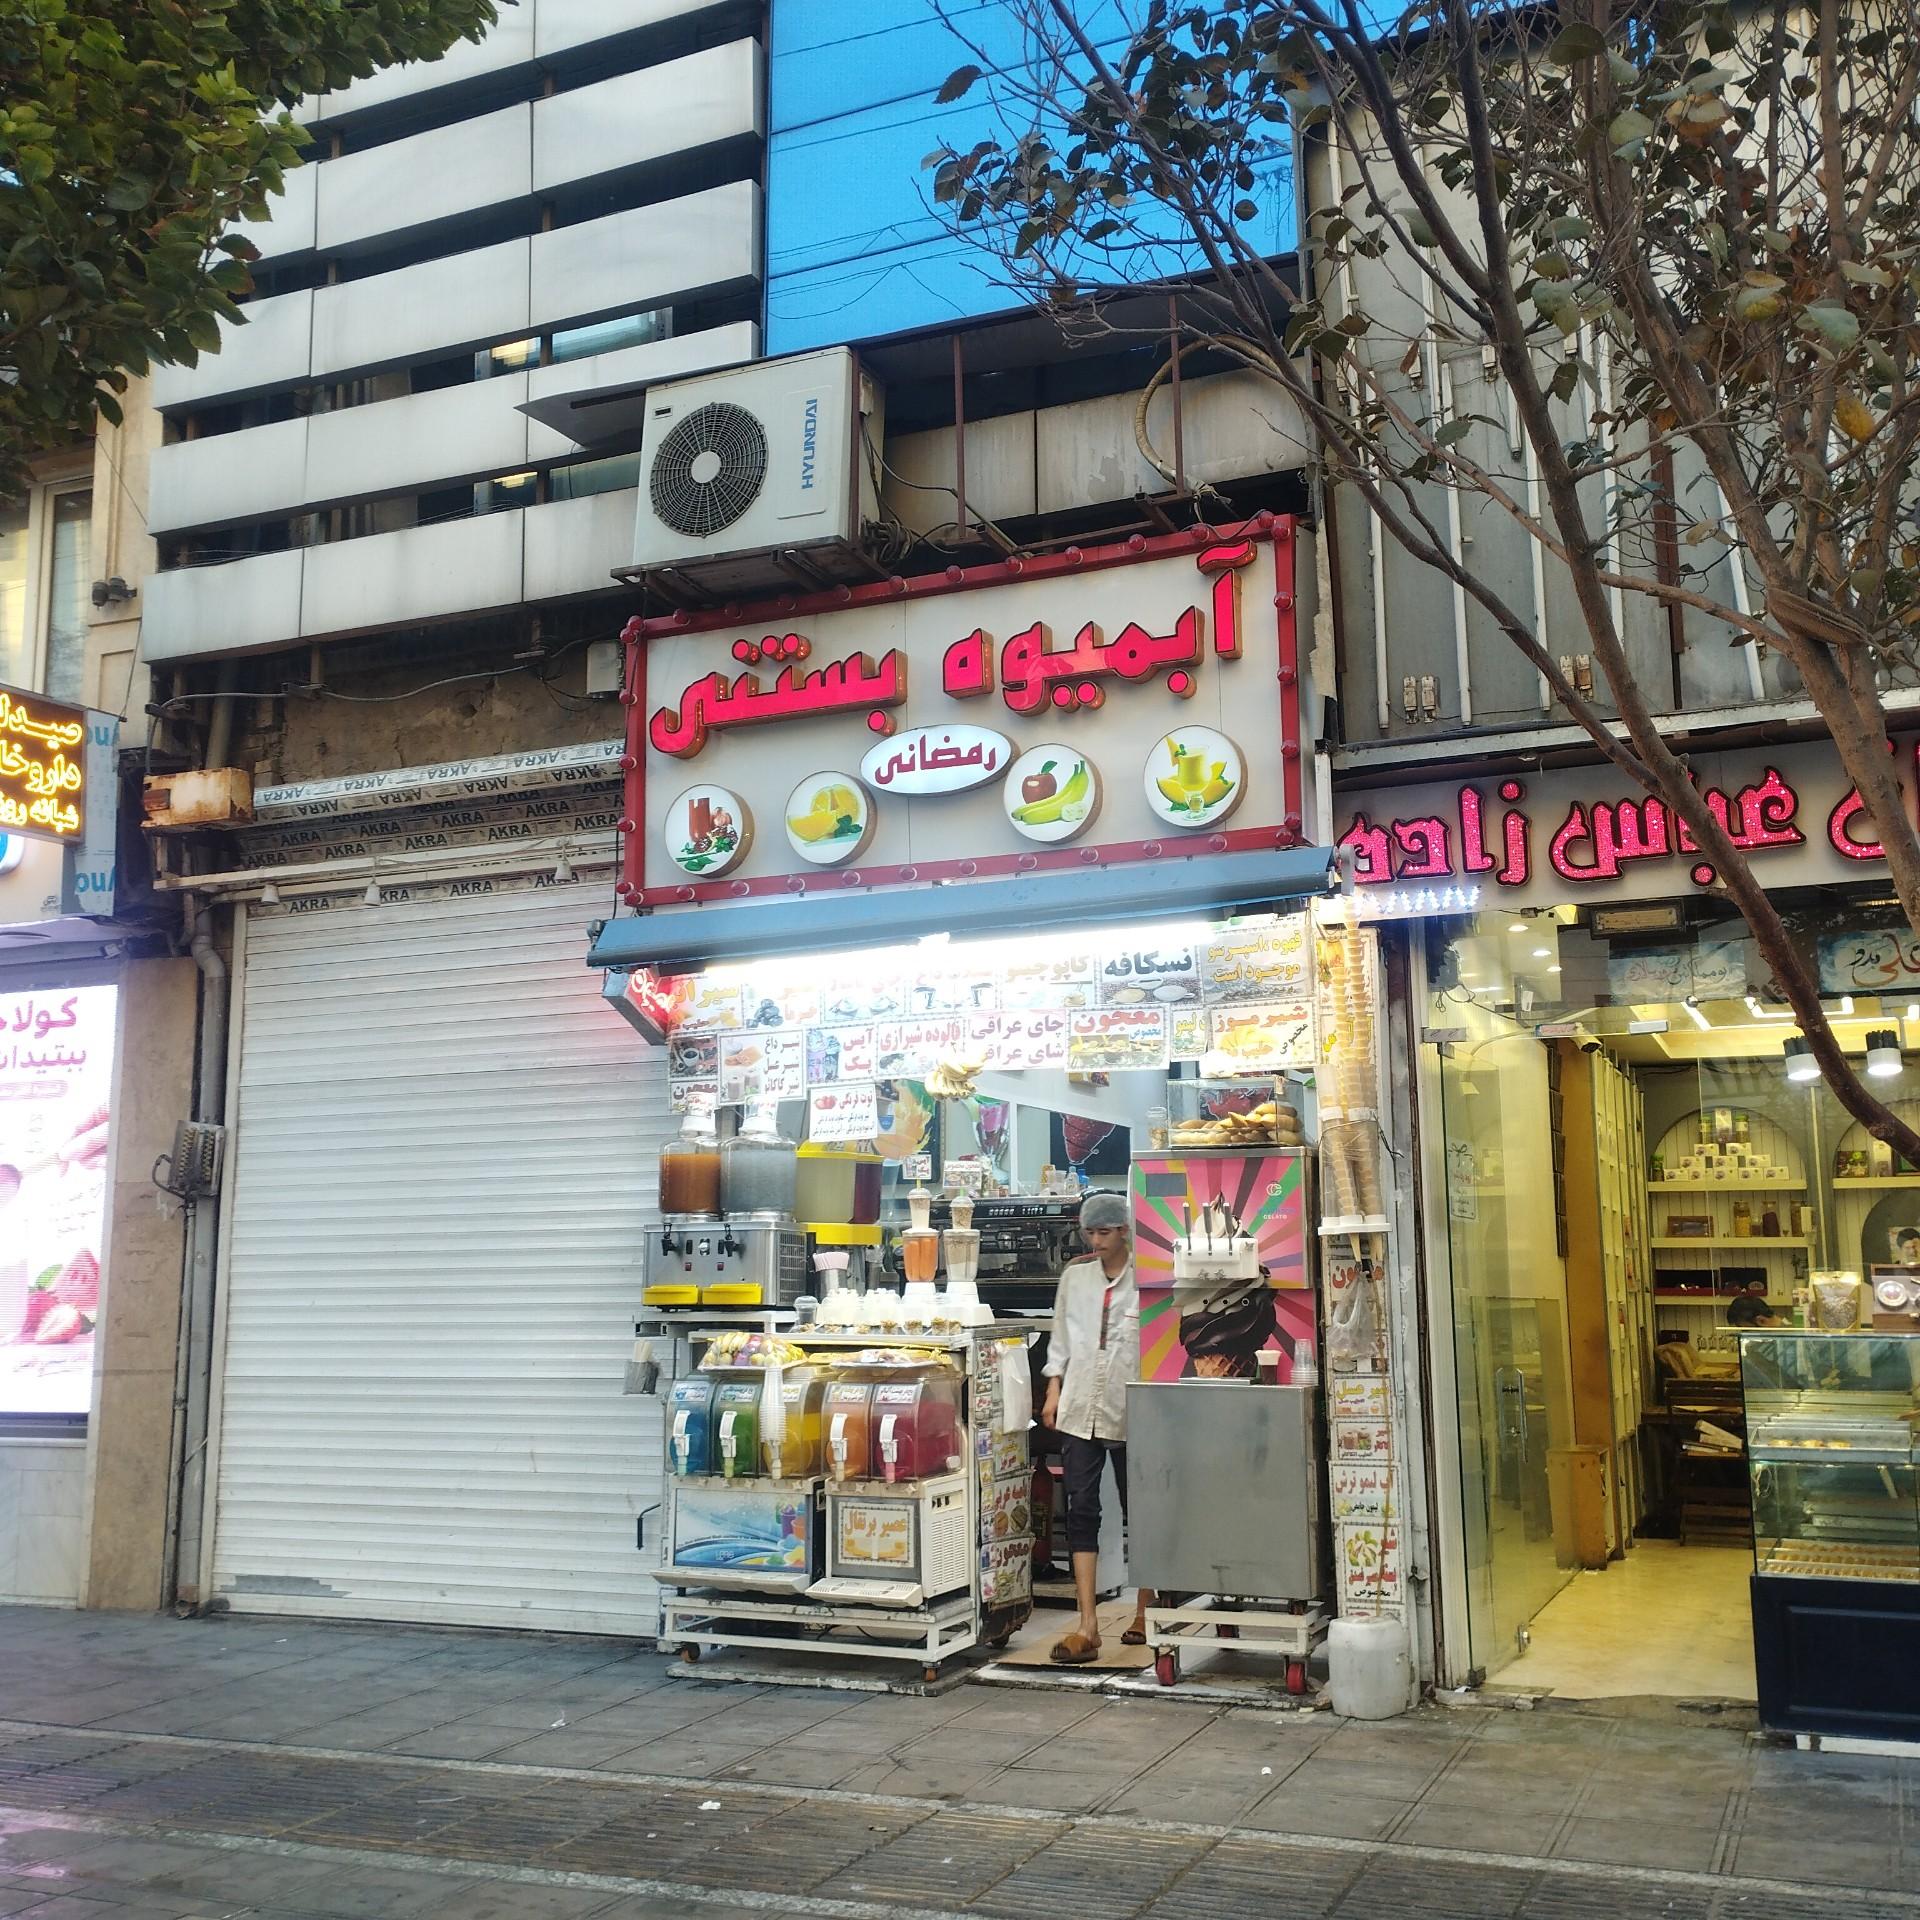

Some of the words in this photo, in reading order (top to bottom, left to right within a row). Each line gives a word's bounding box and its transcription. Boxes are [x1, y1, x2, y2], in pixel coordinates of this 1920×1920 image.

[801, 398, 817, 490] HYUNDAI
[942, 538, 1257, 717] آبمیوه
[648, 632, 907, 759] بستنی
[514, 751, 560, 767] AKRA
[873, 733, 998, 786] رمضانی
[344, 774, 389, 791] AKRA
[427, 763, 471, 780] AKRA
[552, 763, 599, 782] AKRA
[263, 786, 306, 802] AKRA
[379, 787, 423, 804] AKRA
[464, 776, 508, 793] AKRA
[29, 797, 80, 833] شبانه
[297, 799, 339, 816] AKRA
[280, 830, 321, 847] AKRA
[359, 821, 401, 838] AKRA
[441, 810, 485, 828] AKRA
[526, 800, 570, 818] AKRA
[1336, 779, 1532, 886] زاده
[248, 852, 287, 868] AKRA
[325, 843, 366, 860] AKRA
[405, 832, 448, 850] AKRA
[488, 823, 532, 841] AKRA
[574, 813, 619, 831] AKRA
[289, 897, 330, 914] AKRA
[450, 880, 493, 897] AKRA
[534, 871, 580, 889] AKA
[1271, 930, 1303, 956] قهوه
[1104, 946, 1193, 977] نسکافه
[1213, 962, 1243, 984] است
[1245, 963, 1301, 984] موجود
[1027, 1014, 1064, 1038] چای
[1073, 1008, 1161, 1034] معجون
[1215, 1013, 1260, 1033] موز
[1260, 1004, 1309, 1028] شیر
[842, 1027, 875, 1051] آیس
[879, 1024, 923, 1051] شیرازی
[924, 1022, 961, 1045] فالوده
[971, 1016, 1023, 1041] عراقی
[1281, 1022, 1309, 1055] مخصوص
[764, 1036, 778, 1055] داغ
[782, 1034, 800, 1050] شیر
[844, 1057, 873, 1074] پک
[984, 1046, 1023, 1066] عراق
[1028, 1043, 1065, 1065] شای
[1263, 1213, 1288, 1221] GELATO
[1332, 1265, 1385, 1290] مون
[1336, 1380, 1365, 1400] عسل
[1335, 1471, 1357, 1494] ترش
[1359, 1471, 1377, 1495] لیمو
[844, 1510, 877, 1537] برتقال
[880, 1516, 907, 1538] عصیر
[1354, 1587, 1391, 1598] مخصوص
